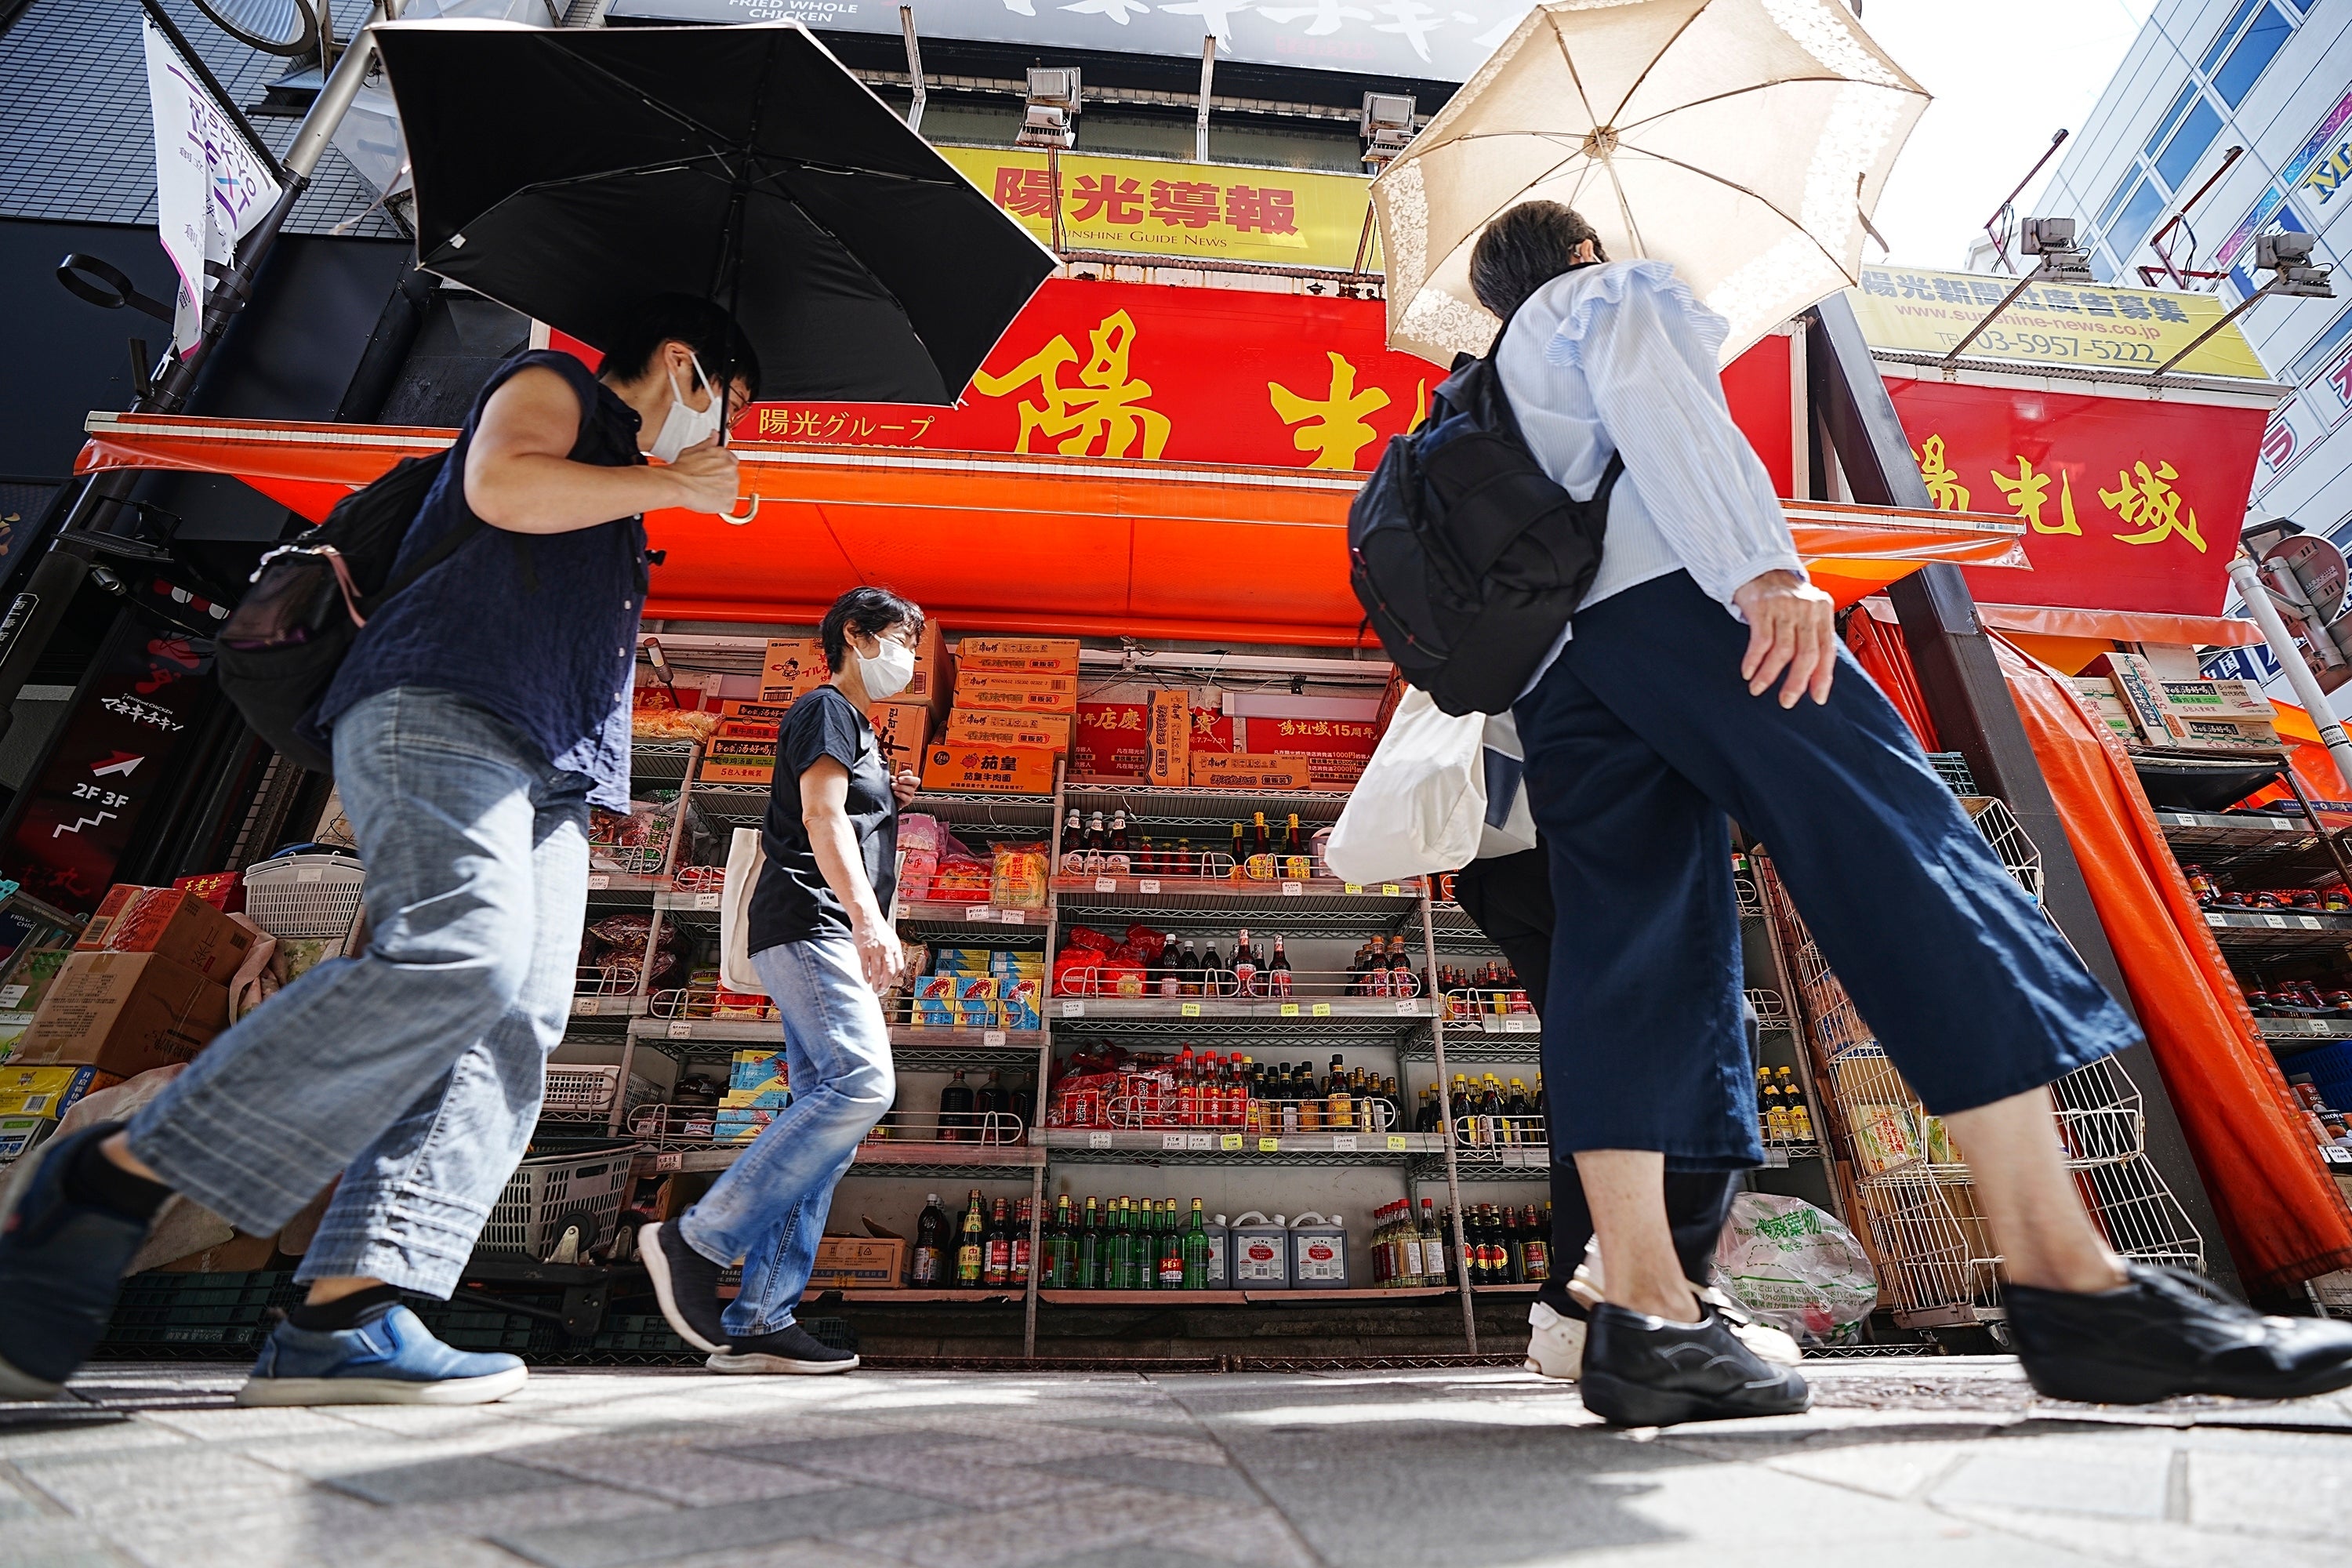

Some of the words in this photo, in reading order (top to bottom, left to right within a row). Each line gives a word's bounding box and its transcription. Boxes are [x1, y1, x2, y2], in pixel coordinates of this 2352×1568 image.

[791, 1, 858, 13] WHOLE
[749, 9, 833, 22] CHICKEN
[992, 166, 1298, 237] 陽光導報
[1055, 227, 1124, 241] UNSHINE
[1976, 329, 2161, 364] 03-5957-5222
[758, 408, 935, 441] 陽光グループ
[101, 698, 184, 731] マネキチキン
[981, 755, 1018, 771] 茄皇
[720, 768, 762, 777] 5包入量贩装
[964, 771, 1011, 782] 茄皇牛肉面
[72, 783, 101, 800] 2F
[101, 791, 129, 808] 3F
